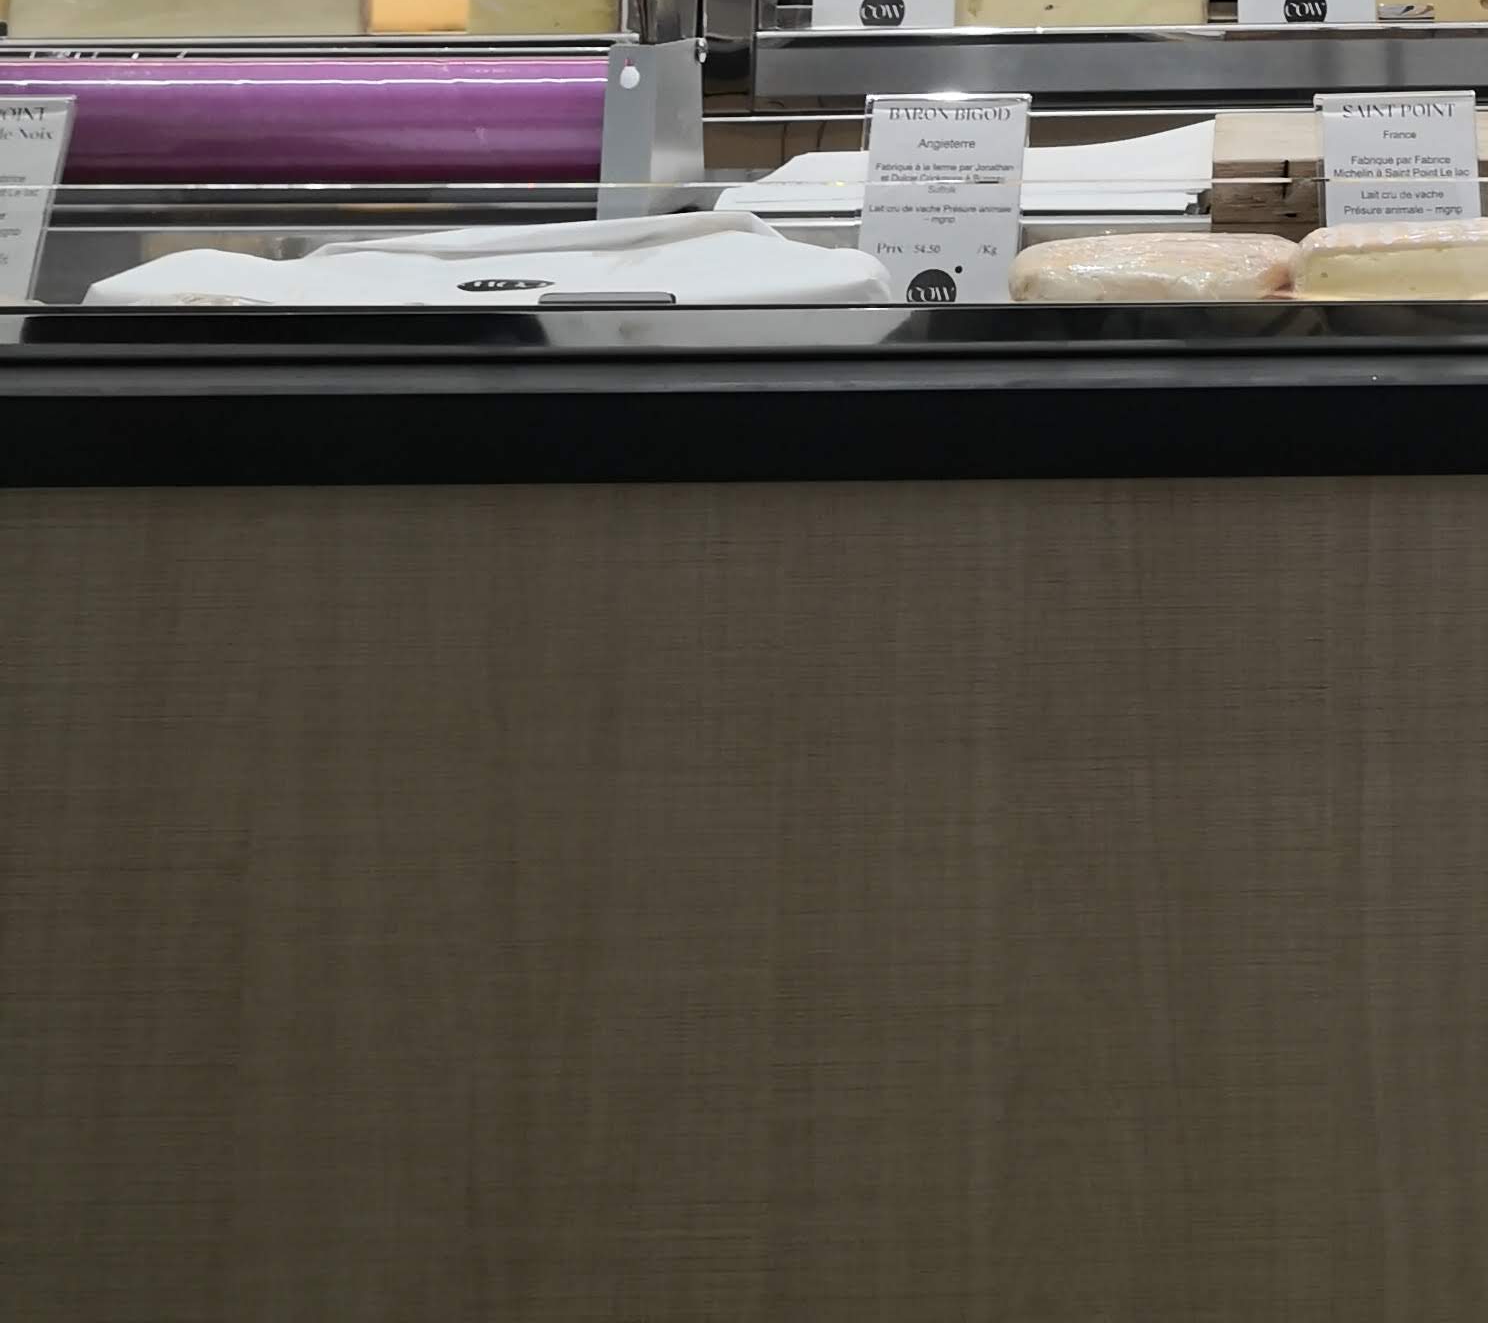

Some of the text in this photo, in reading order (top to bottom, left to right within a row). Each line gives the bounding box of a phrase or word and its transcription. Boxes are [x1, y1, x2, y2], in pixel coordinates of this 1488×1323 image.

[0, 107, 46, 121] OINT
[889, 108, 1011, 121] BARON BIGOD
[1343, 103, 1455, 118] SAINT POINT
[1383, 130, 1416, 139] France
[1351, 156, 1451, 166] Fabriqué par Fabrice
[959, 163, 972, 172] par
[975, 163, 1014, 172] Jonathan
[1334, 169, 1373, 177] Michelin
[1385, 168, 1410, 177] Saint
[1413, 168, 1438, 177] Point
[1440, 168, 1452, 177] Le
[1455, 168, 1469, 176] lac
[1361, 191, 1444, 199] Lait cru de vache
[1344, 206, 1383, 215] Présure
[1385, 206, 1424, 215] animale
[1435, 207, 1463, 215] mgnp
[877, 243, 903, 254] Prix
